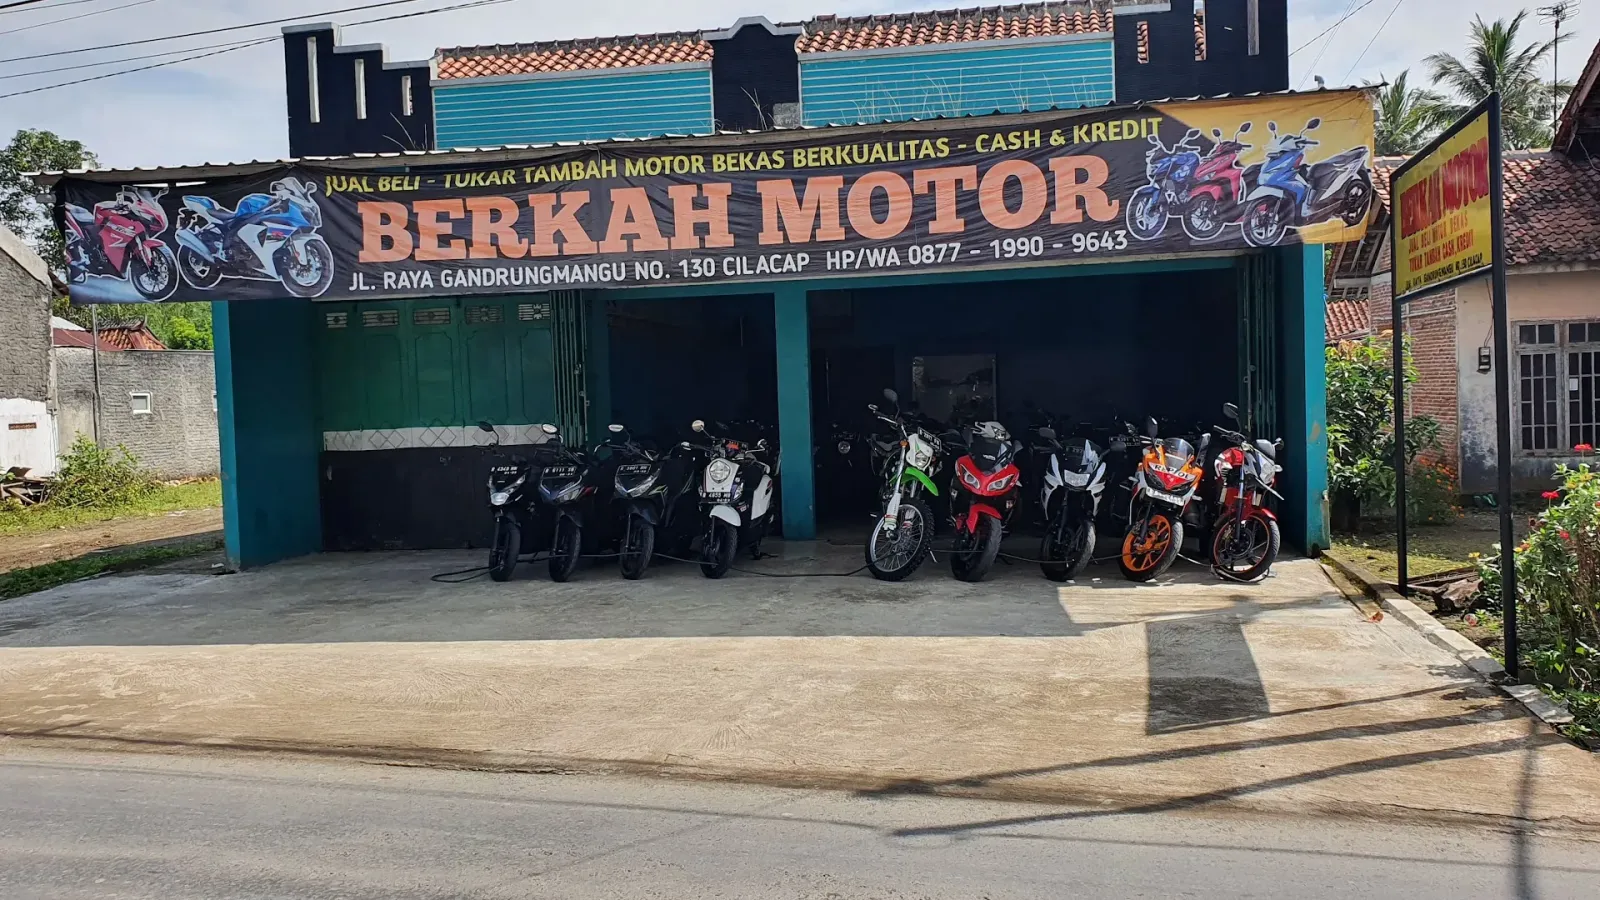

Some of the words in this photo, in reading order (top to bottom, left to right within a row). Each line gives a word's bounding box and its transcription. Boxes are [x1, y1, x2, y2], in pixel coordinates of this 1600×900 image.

[325, 175, 374, 197] JUAL
[378, 174, 420, 191] BELI
[444, 169, 516, 188] TUKAR
[524, 159, 616, 183] TAMBAH
[624, 154, 705, 176] MOTOR
[712, 150, 785, 173] BEKAS
[792, 137, 949, 168] BERKUALITAS
[975, 129, 1041, 153] CASH
[1049, 129, 1066, 146] &
[1073, 117, 1162, 143] KREDIT
[357, 182, 735, 263] BERKAH
[756, 154, 1120, 245] MOTOR
[348, 271, 376, 291] JL.
[383, 269, 434, 290] RAYA
[440, 262, 626, 288] GANDRUNGMANGU
[635, 260, 670, 281] NO.
[678, 257, 715, 278] 130
[722, 252, 810, 277] CILACAP
[826, 246, 900, 271] HP/WA
[908, 241, 961, 265] 0877
[989, 235, 1043, 259] 1990
[1072, 230, 1128, 253] 9643
